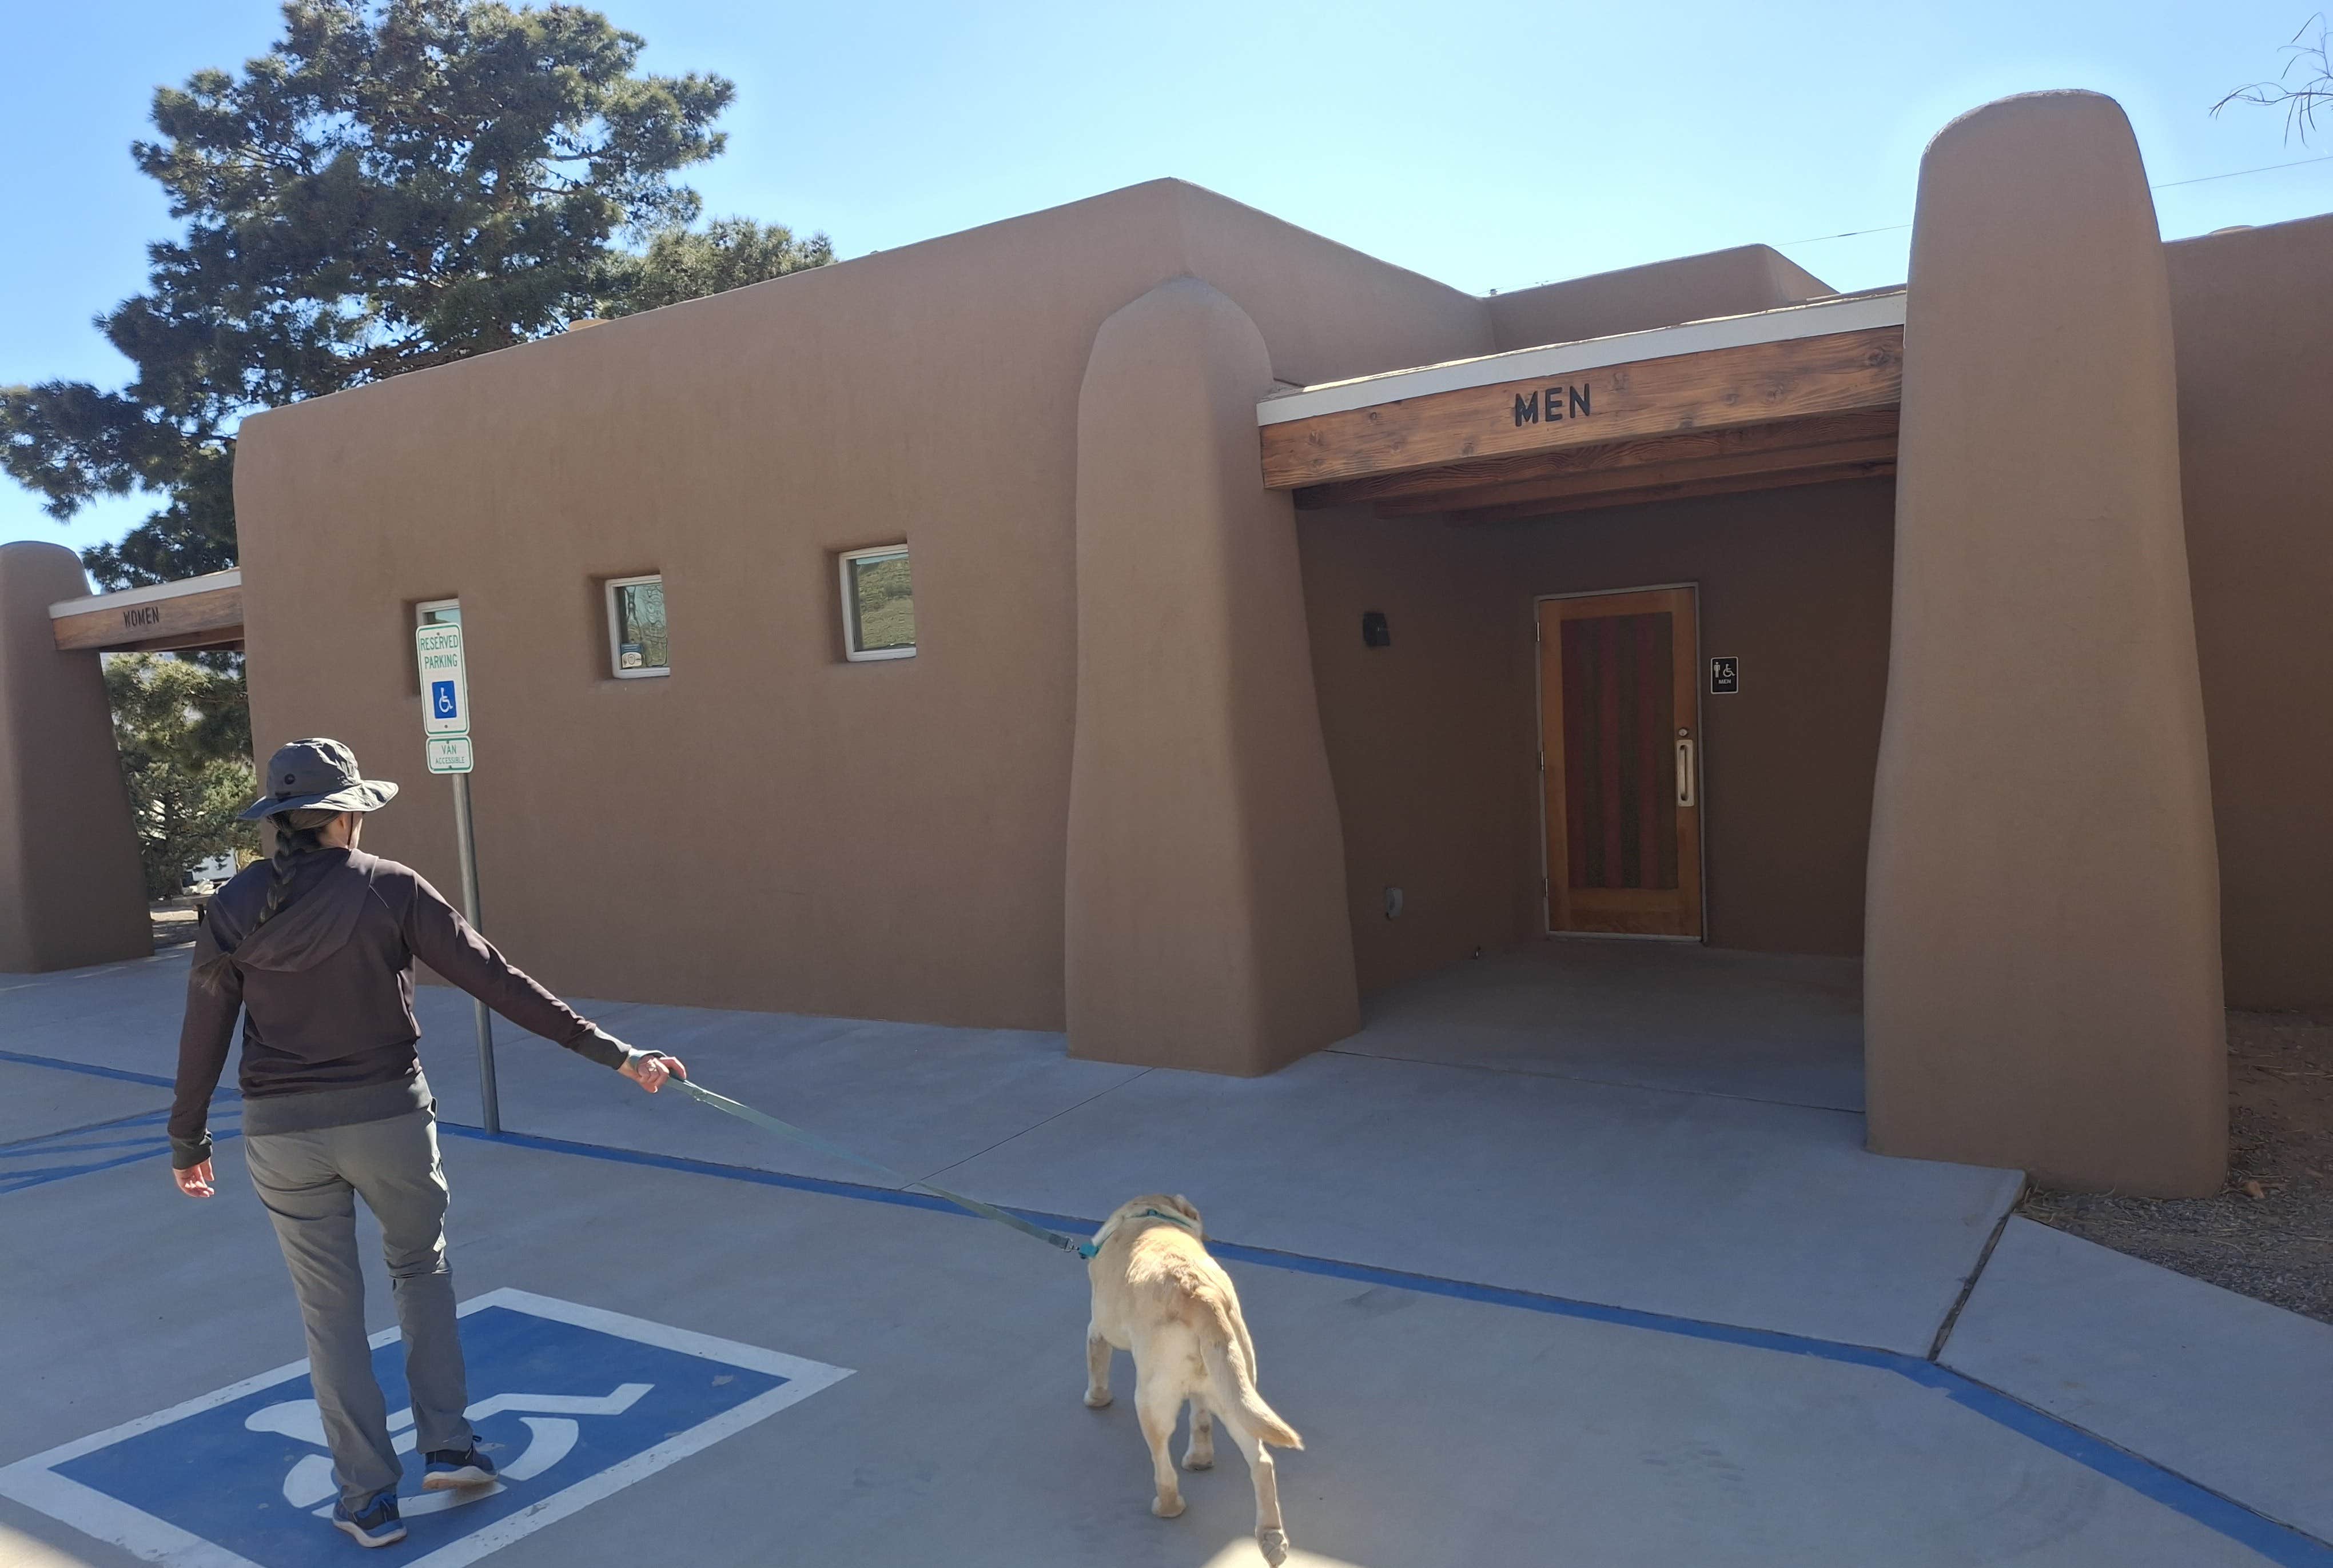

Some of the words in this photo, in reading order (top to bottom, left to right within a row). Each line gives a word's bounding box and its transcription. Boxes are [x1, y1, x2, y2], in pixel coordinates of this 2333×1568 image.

[1515, 383, 1590, 427] MEN
[123, 607, 160, 627] WOMEN
[420, 635, 459, 651] RESERVED
[424, 653, 458, 669] PARKING
[441, 744, 457, 755] VAN
[435, 756, 465, 764] ACCESSIBLE
